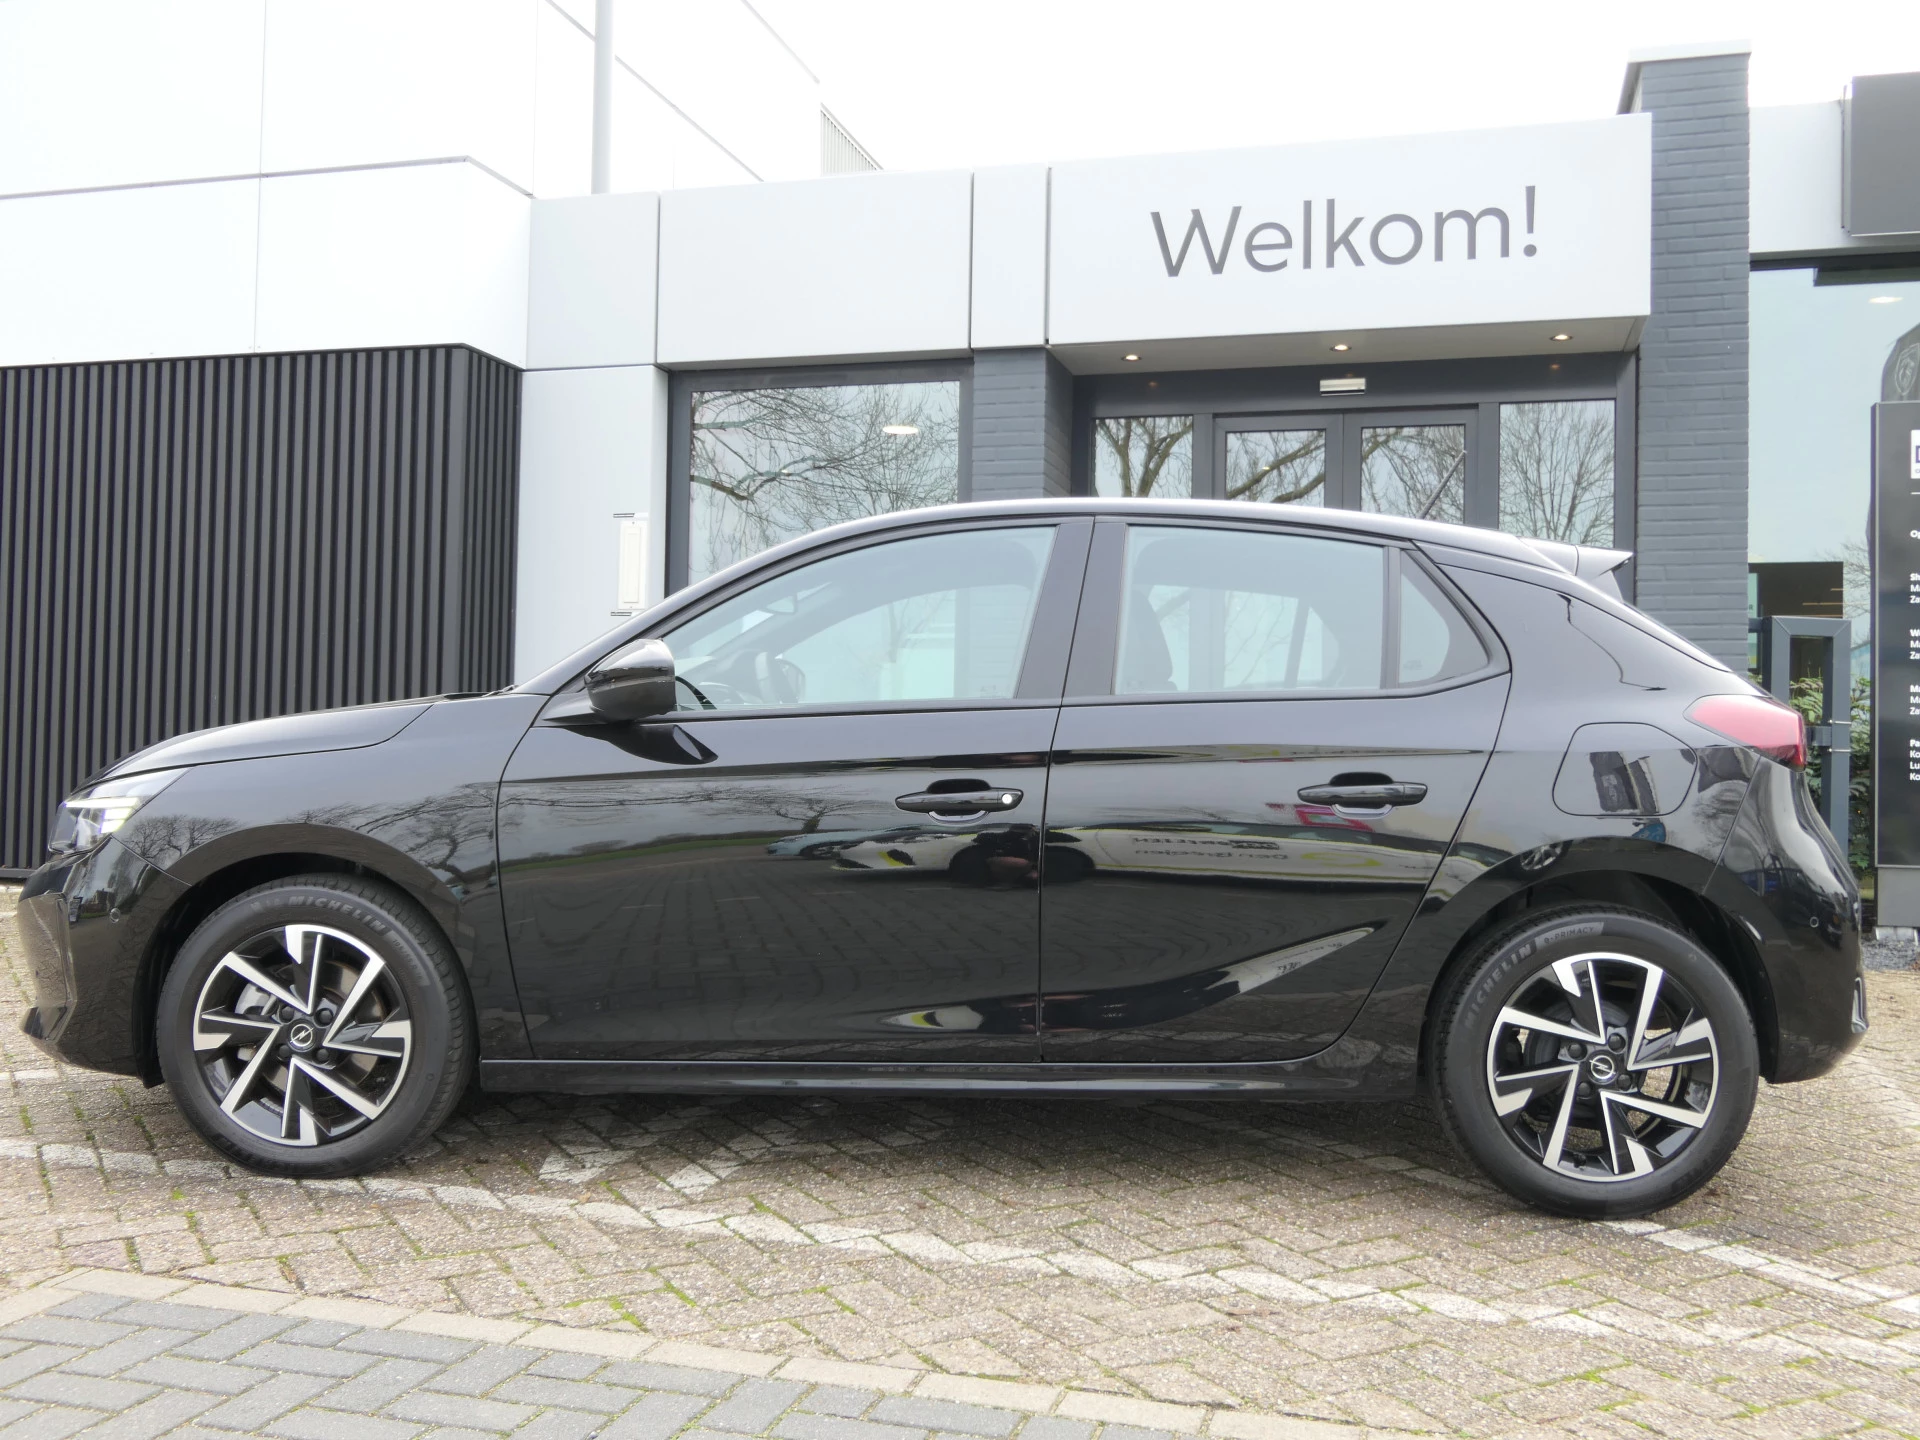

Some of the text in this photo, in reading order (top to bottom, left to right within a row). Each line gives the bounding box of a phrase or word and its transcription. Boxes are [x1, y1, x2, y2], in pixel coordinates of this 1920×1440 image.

[1150, 185, 1538, 278] Welkom!
[288, 896, 386, 932] MICHELIN
[1465, 943, 1532, 1028] MICHELIN
